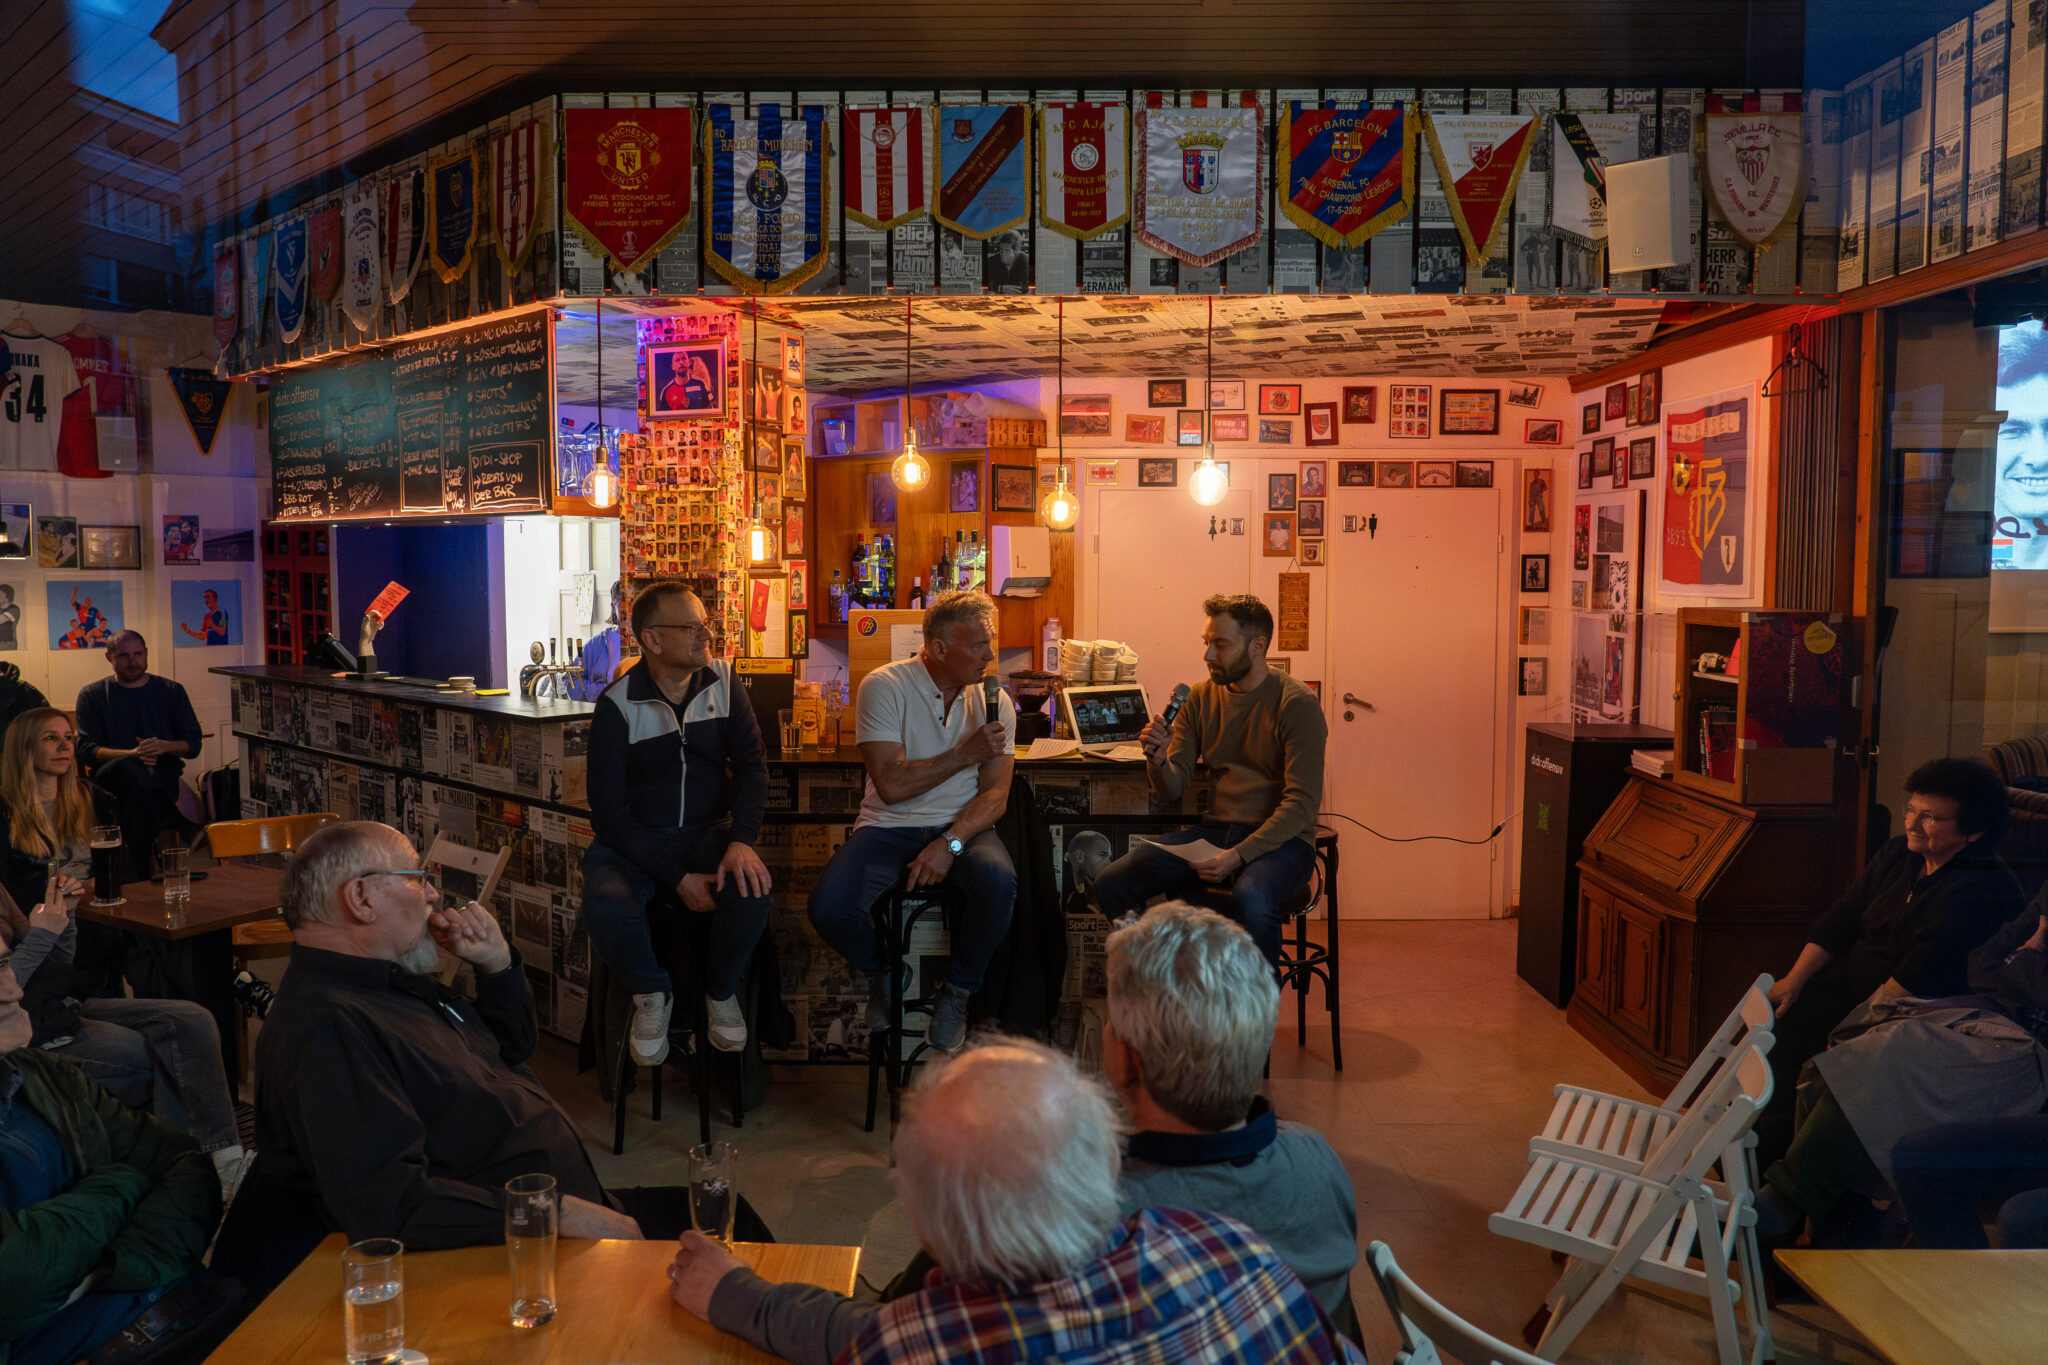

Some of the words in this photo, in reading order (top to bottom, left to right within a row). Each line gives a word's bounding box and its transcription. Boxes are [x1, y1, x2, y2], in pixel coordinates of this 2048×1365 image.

[1053, 119, 1076, 133] AFC
[1082, 117, 1116, 132] AJAX
[1308, 124, 1322, 138] FC
[1324, 118, 1389, 139] BARCELONA
[1723, 122, 1767, 142] SEVILLA
[601, 126, 656, 149] MANCHESTER
[713, 128, 727, 139] AO
[720, 139, 760, 152] BAYERN
[611, 172, 649, 185] UNITED
[1340, 168, 1352, 177] AL
[1297, 175, 1317, 195] FINAL
[1318, 189, 1363, 203] CHAMPIONS
[1364, 178, 1395, 199] LEAGUE
[1320, 177, 1358, 191] ARSENAL
[1359, 178, 1371, 188] FC
[763, 213, 801, 224] PORTO
[754, 242, 780, 252] FINAL
[1705, 249, 1737, 264] HERR
[1705, 265, 1725, 279] WE
[1083, 281, 1126, 292] GERMANS
[1704, 281, 1721, 295] GO
[5, 373, 47, 422] 34
[82, 375, 98, 415] 1
[475, 386, 507, 402] SHOTS
[475, 404, 538, 421] LONGDRINKS
[1695, 412, 1735, 438] BASEL
[471, 451, 524, 469] DIDI-SHOP
[505, 471, 524, 484] VON
[473, 489, 493, 504] DER
[492, 484, 517, 498] BAR
[1068, 919, 1097, 930] Sport
